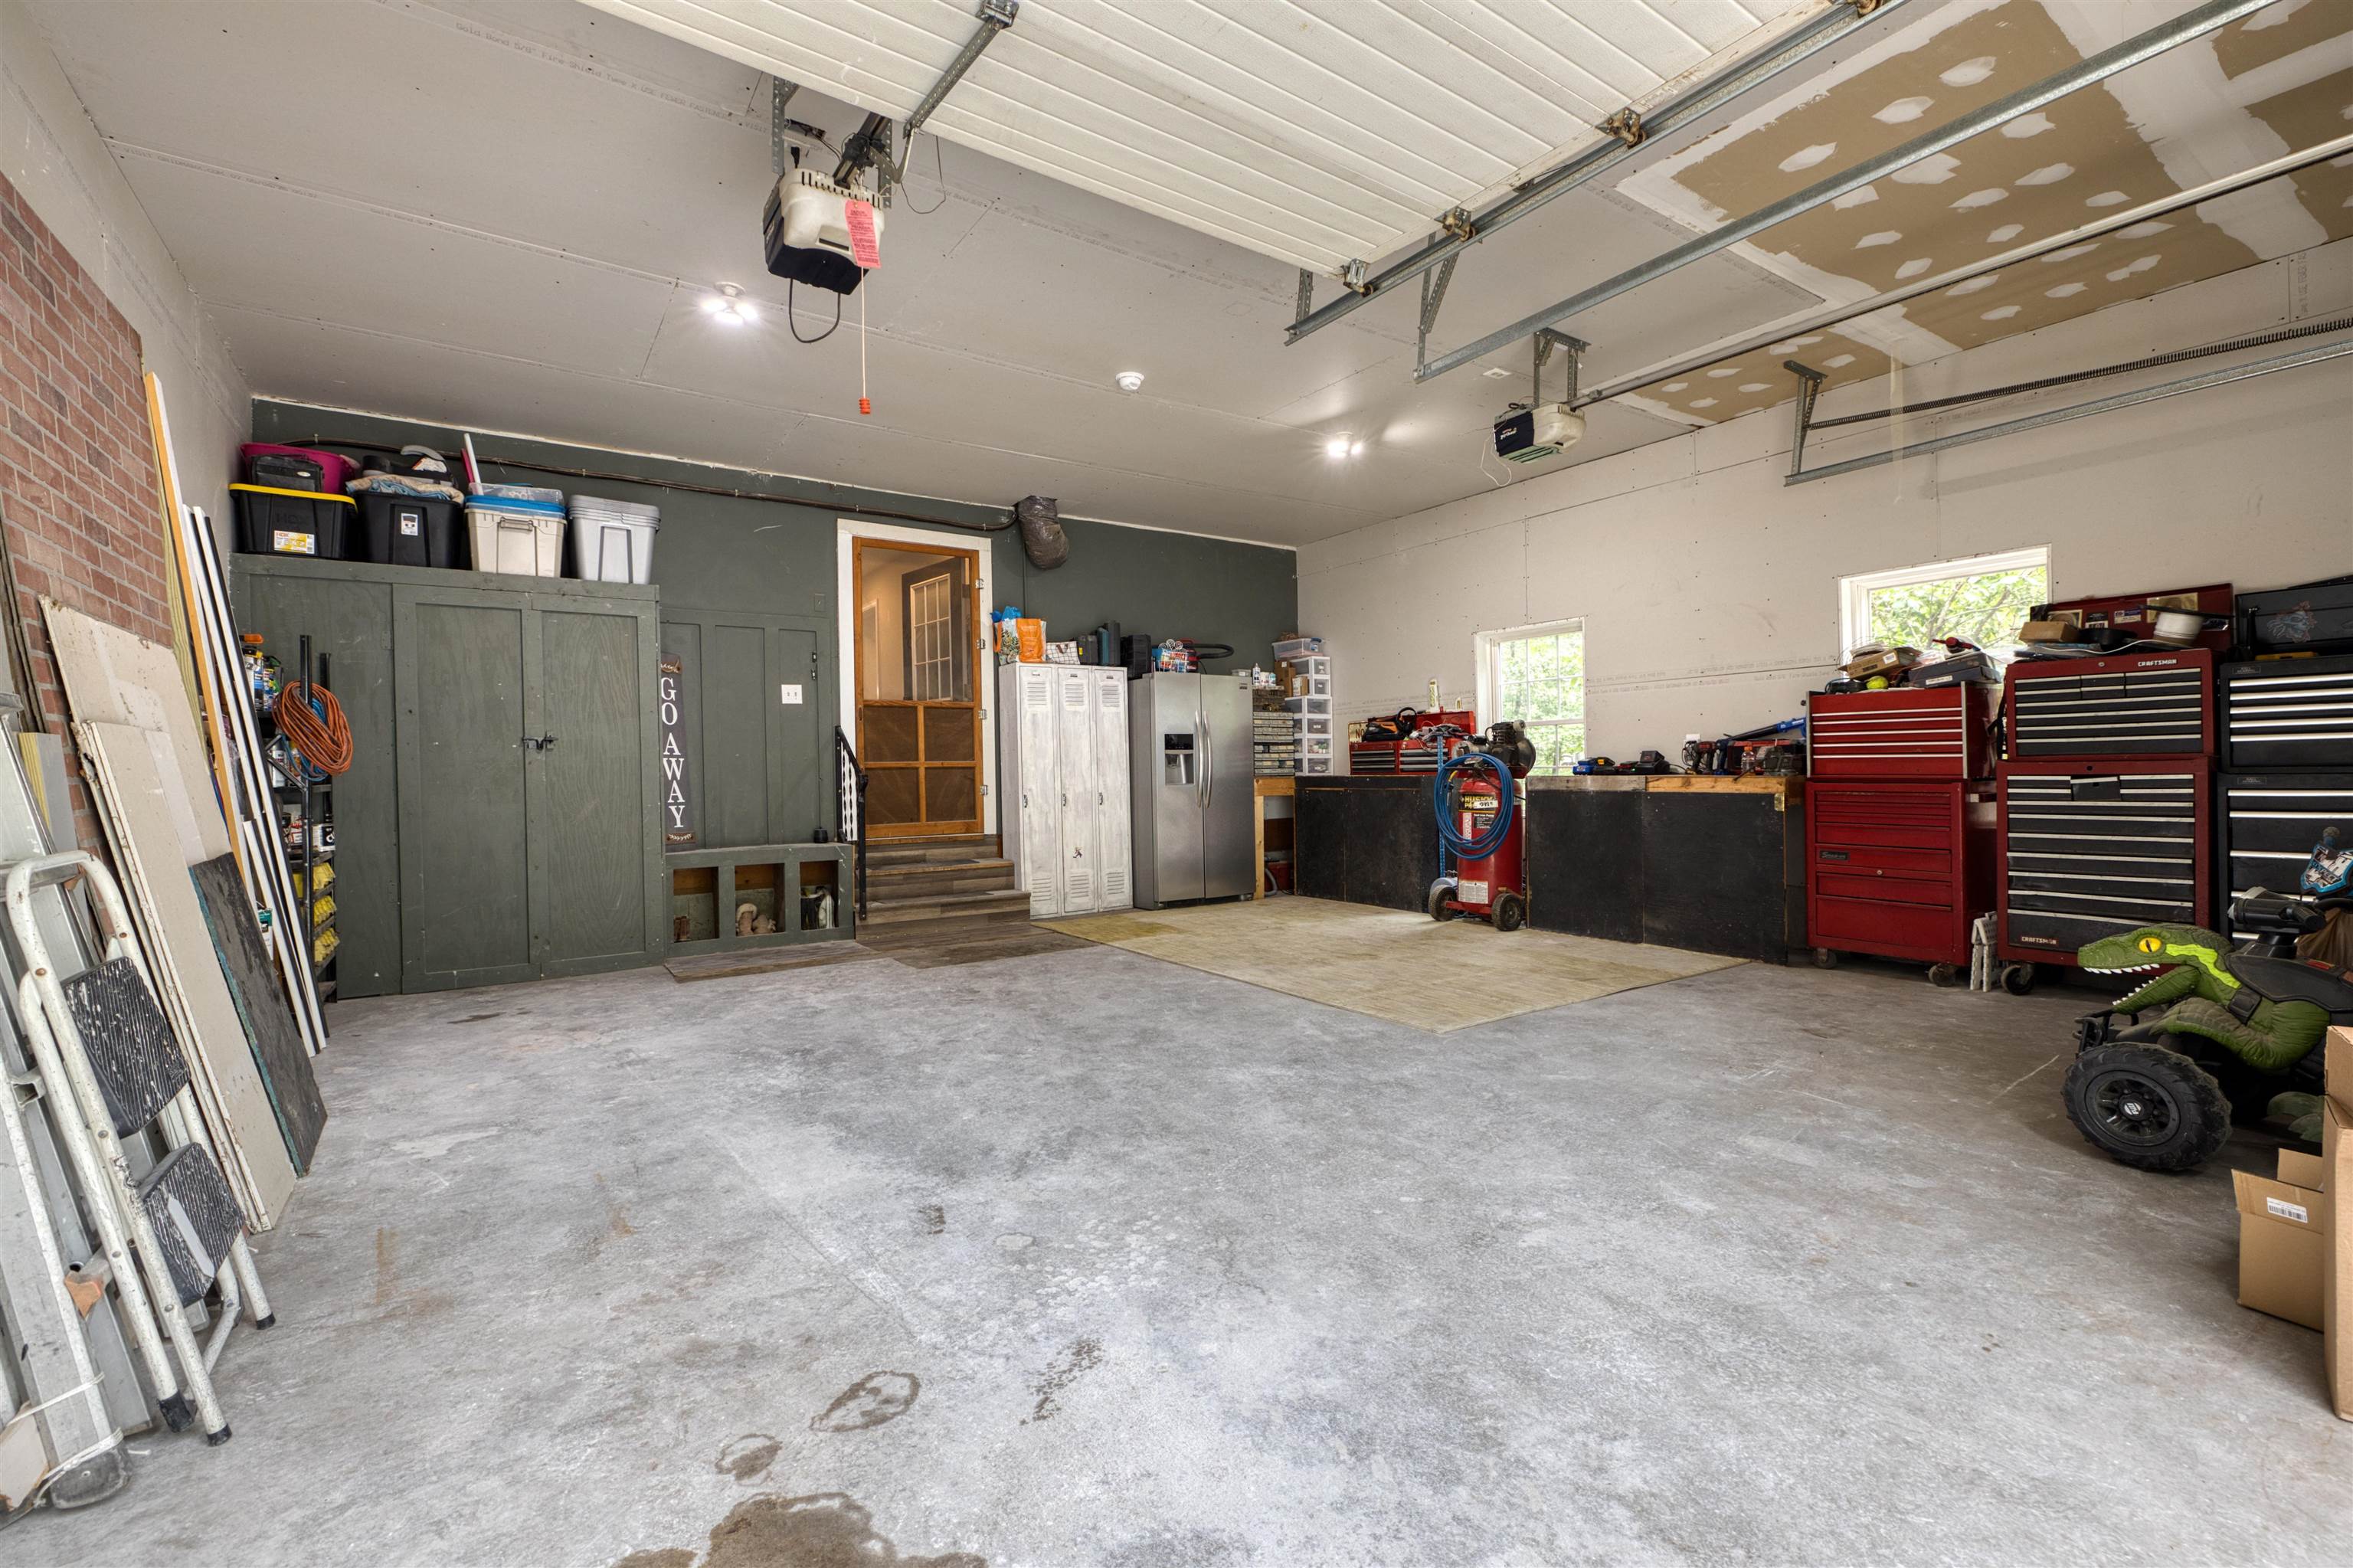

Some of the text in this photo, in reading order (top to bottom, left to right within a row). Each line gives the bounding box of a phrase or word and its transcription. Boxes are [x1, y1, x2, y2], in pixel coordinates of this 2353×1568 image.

[486, 33, 509, 46] Bond
[2138, 659, 2177, 667] CRAFTSMAN
[660, 677, 678, 725] GO
[663, 732, 686, 828] AWAY
